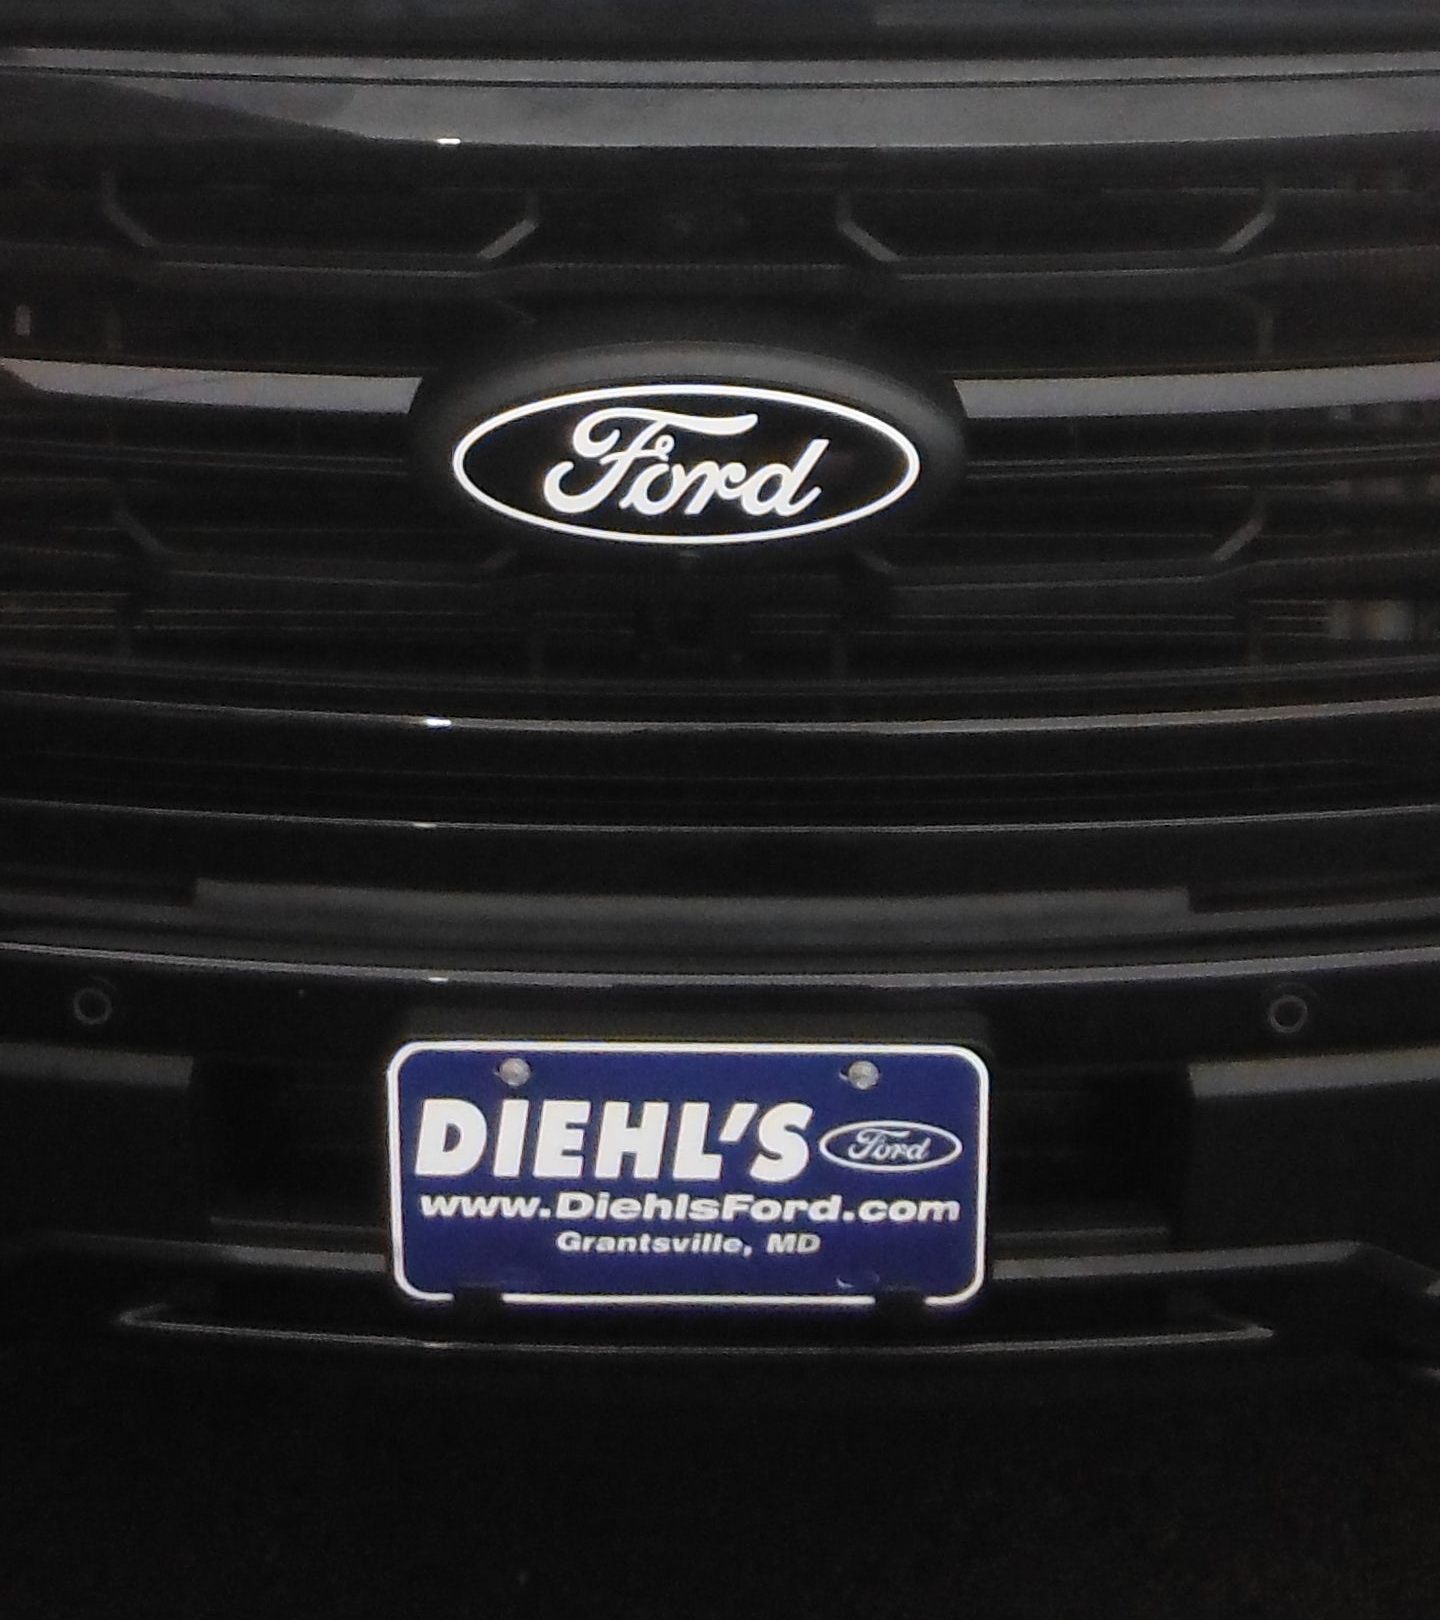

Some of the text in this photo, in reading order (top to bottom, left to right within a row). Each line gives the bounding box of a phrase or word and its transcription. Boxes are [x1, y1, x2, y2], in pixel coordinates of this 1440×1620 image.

[544, 406, 830, 516] Ford
[415, 1098, 931, 1182] DIEHL'S Ford
[420, 1191, 960, 1222] www.DiehlsFord.com
[556, 1230, 821, 1258] Grantsville, MD
